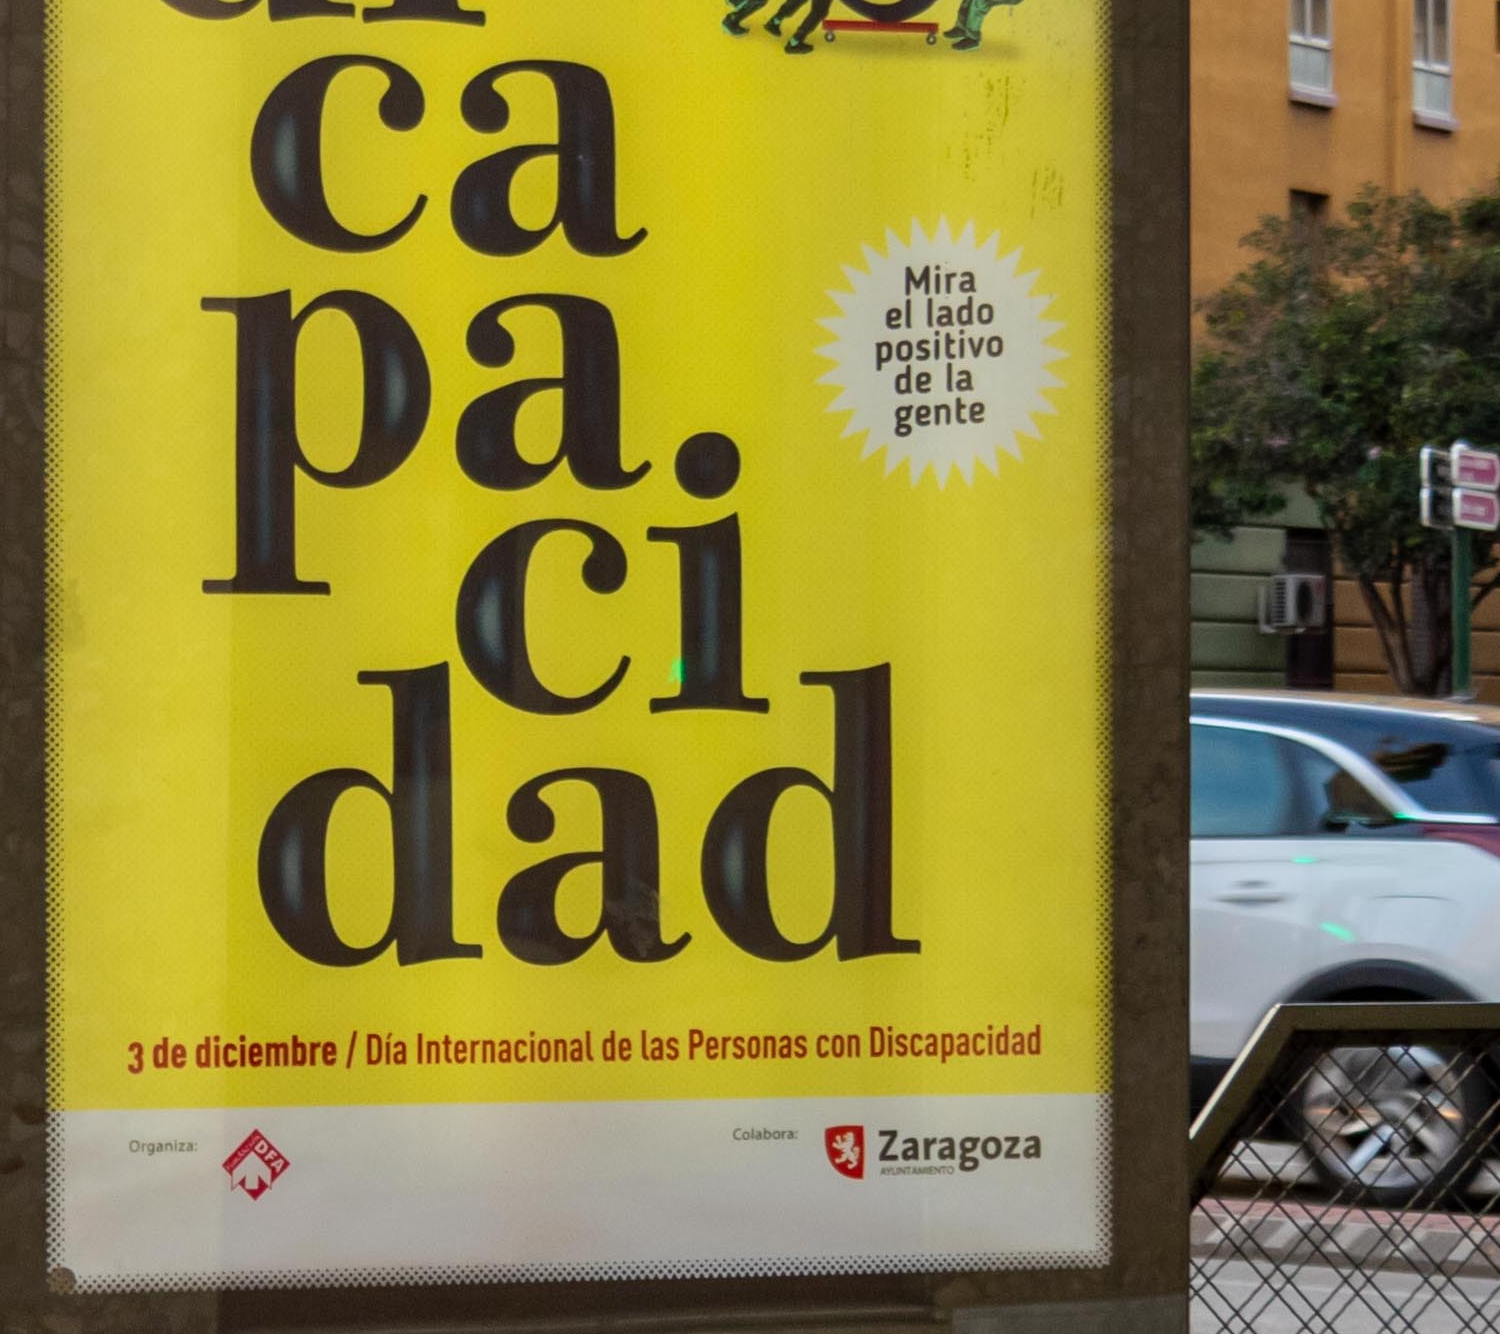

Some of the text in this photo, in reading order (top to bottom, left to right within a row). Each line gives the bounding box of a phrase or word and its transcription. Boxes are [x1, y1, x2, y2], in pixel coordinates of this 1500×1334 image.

[250, 54, 649, 257] ca
[904, 265, 976, 296] Mira
[885, 296, 994, 330] el lado
[875, 330, 1005, 371] positivo
[894, 363, 974, 394] de la
[894, 397, 985, 438] gente
[200, 287, 653, 597] pa
[455, 431, 770, 716] ci
[256, 658, 922, 968] dad
[127, 1024, 1043, 1074] 3 de diciembre / Día Internacional de las Personas con Discapacidad
[128, 1139, 199, 1156] Organiza:
[732, 1128, 799, 1142] Colabora:
[878, 1129, 1042, 1172] Zaragoza
[253, 1139, 285, 1173] DFA
[879, 1165, 955, 1177] AYUNTAMIENTO
